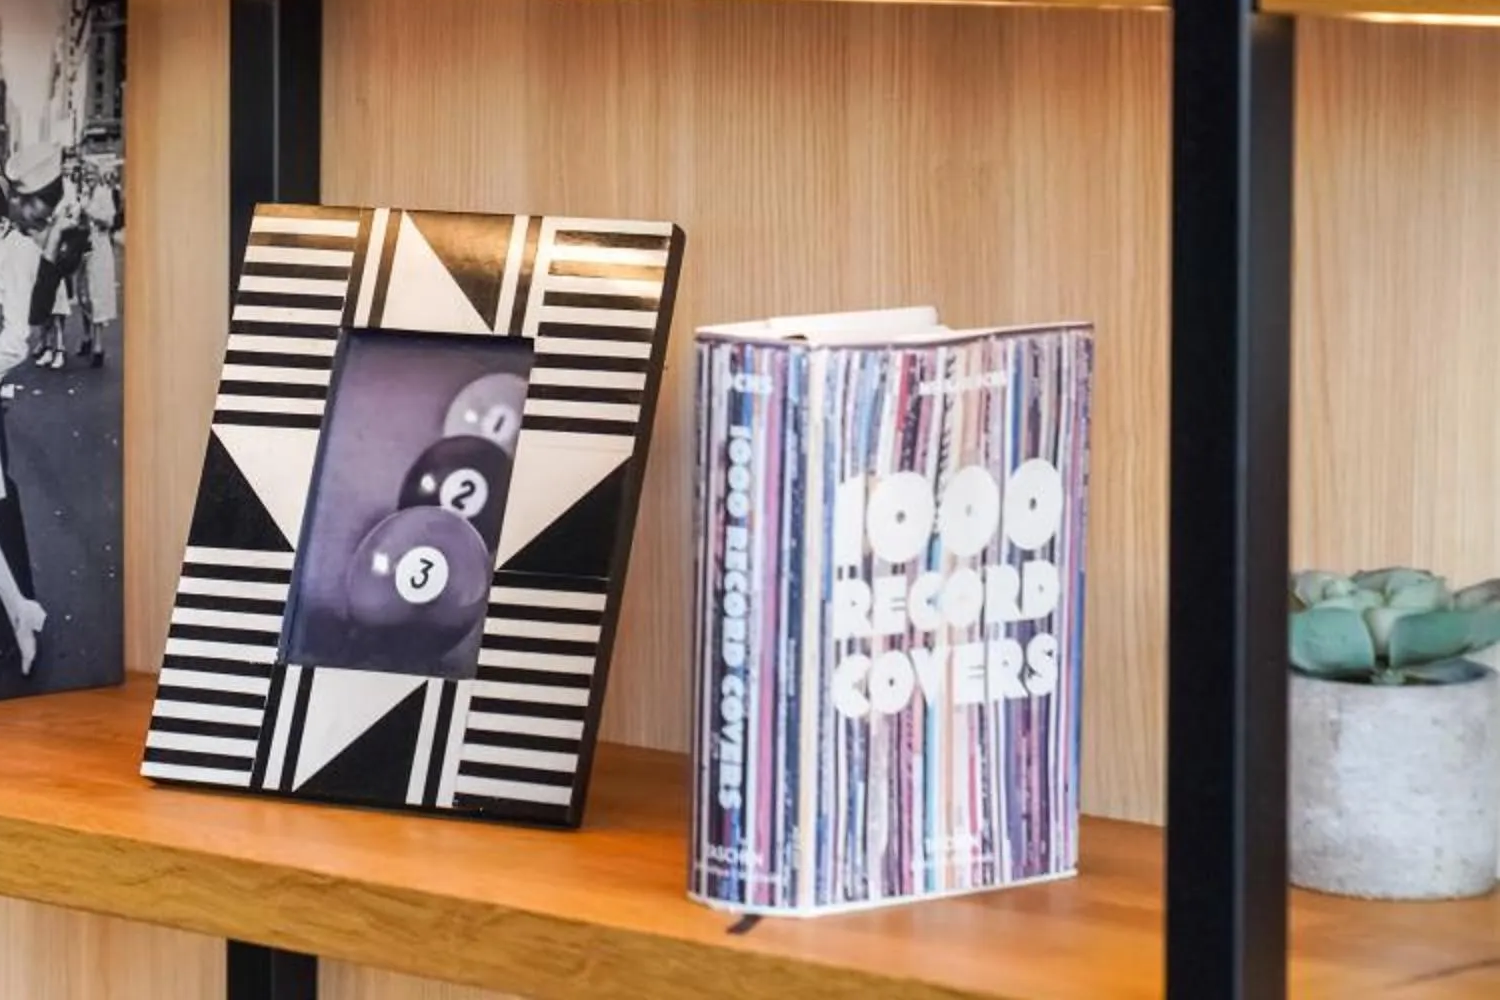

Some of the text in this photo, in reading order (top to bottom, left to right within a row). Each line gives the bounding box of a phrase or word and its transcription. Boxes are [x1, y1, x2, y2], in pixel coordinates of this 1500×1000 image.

[450, 479, 477, 511] 2
[833, 457, 1065, 566] 1000
[409, 557, 435, 590] 3
[833, 559, 1060, 638] RECORD
[718, 424, 752, 812] 1000 RECORD COVERS
[831, 632, 1059, 719] COVERS
